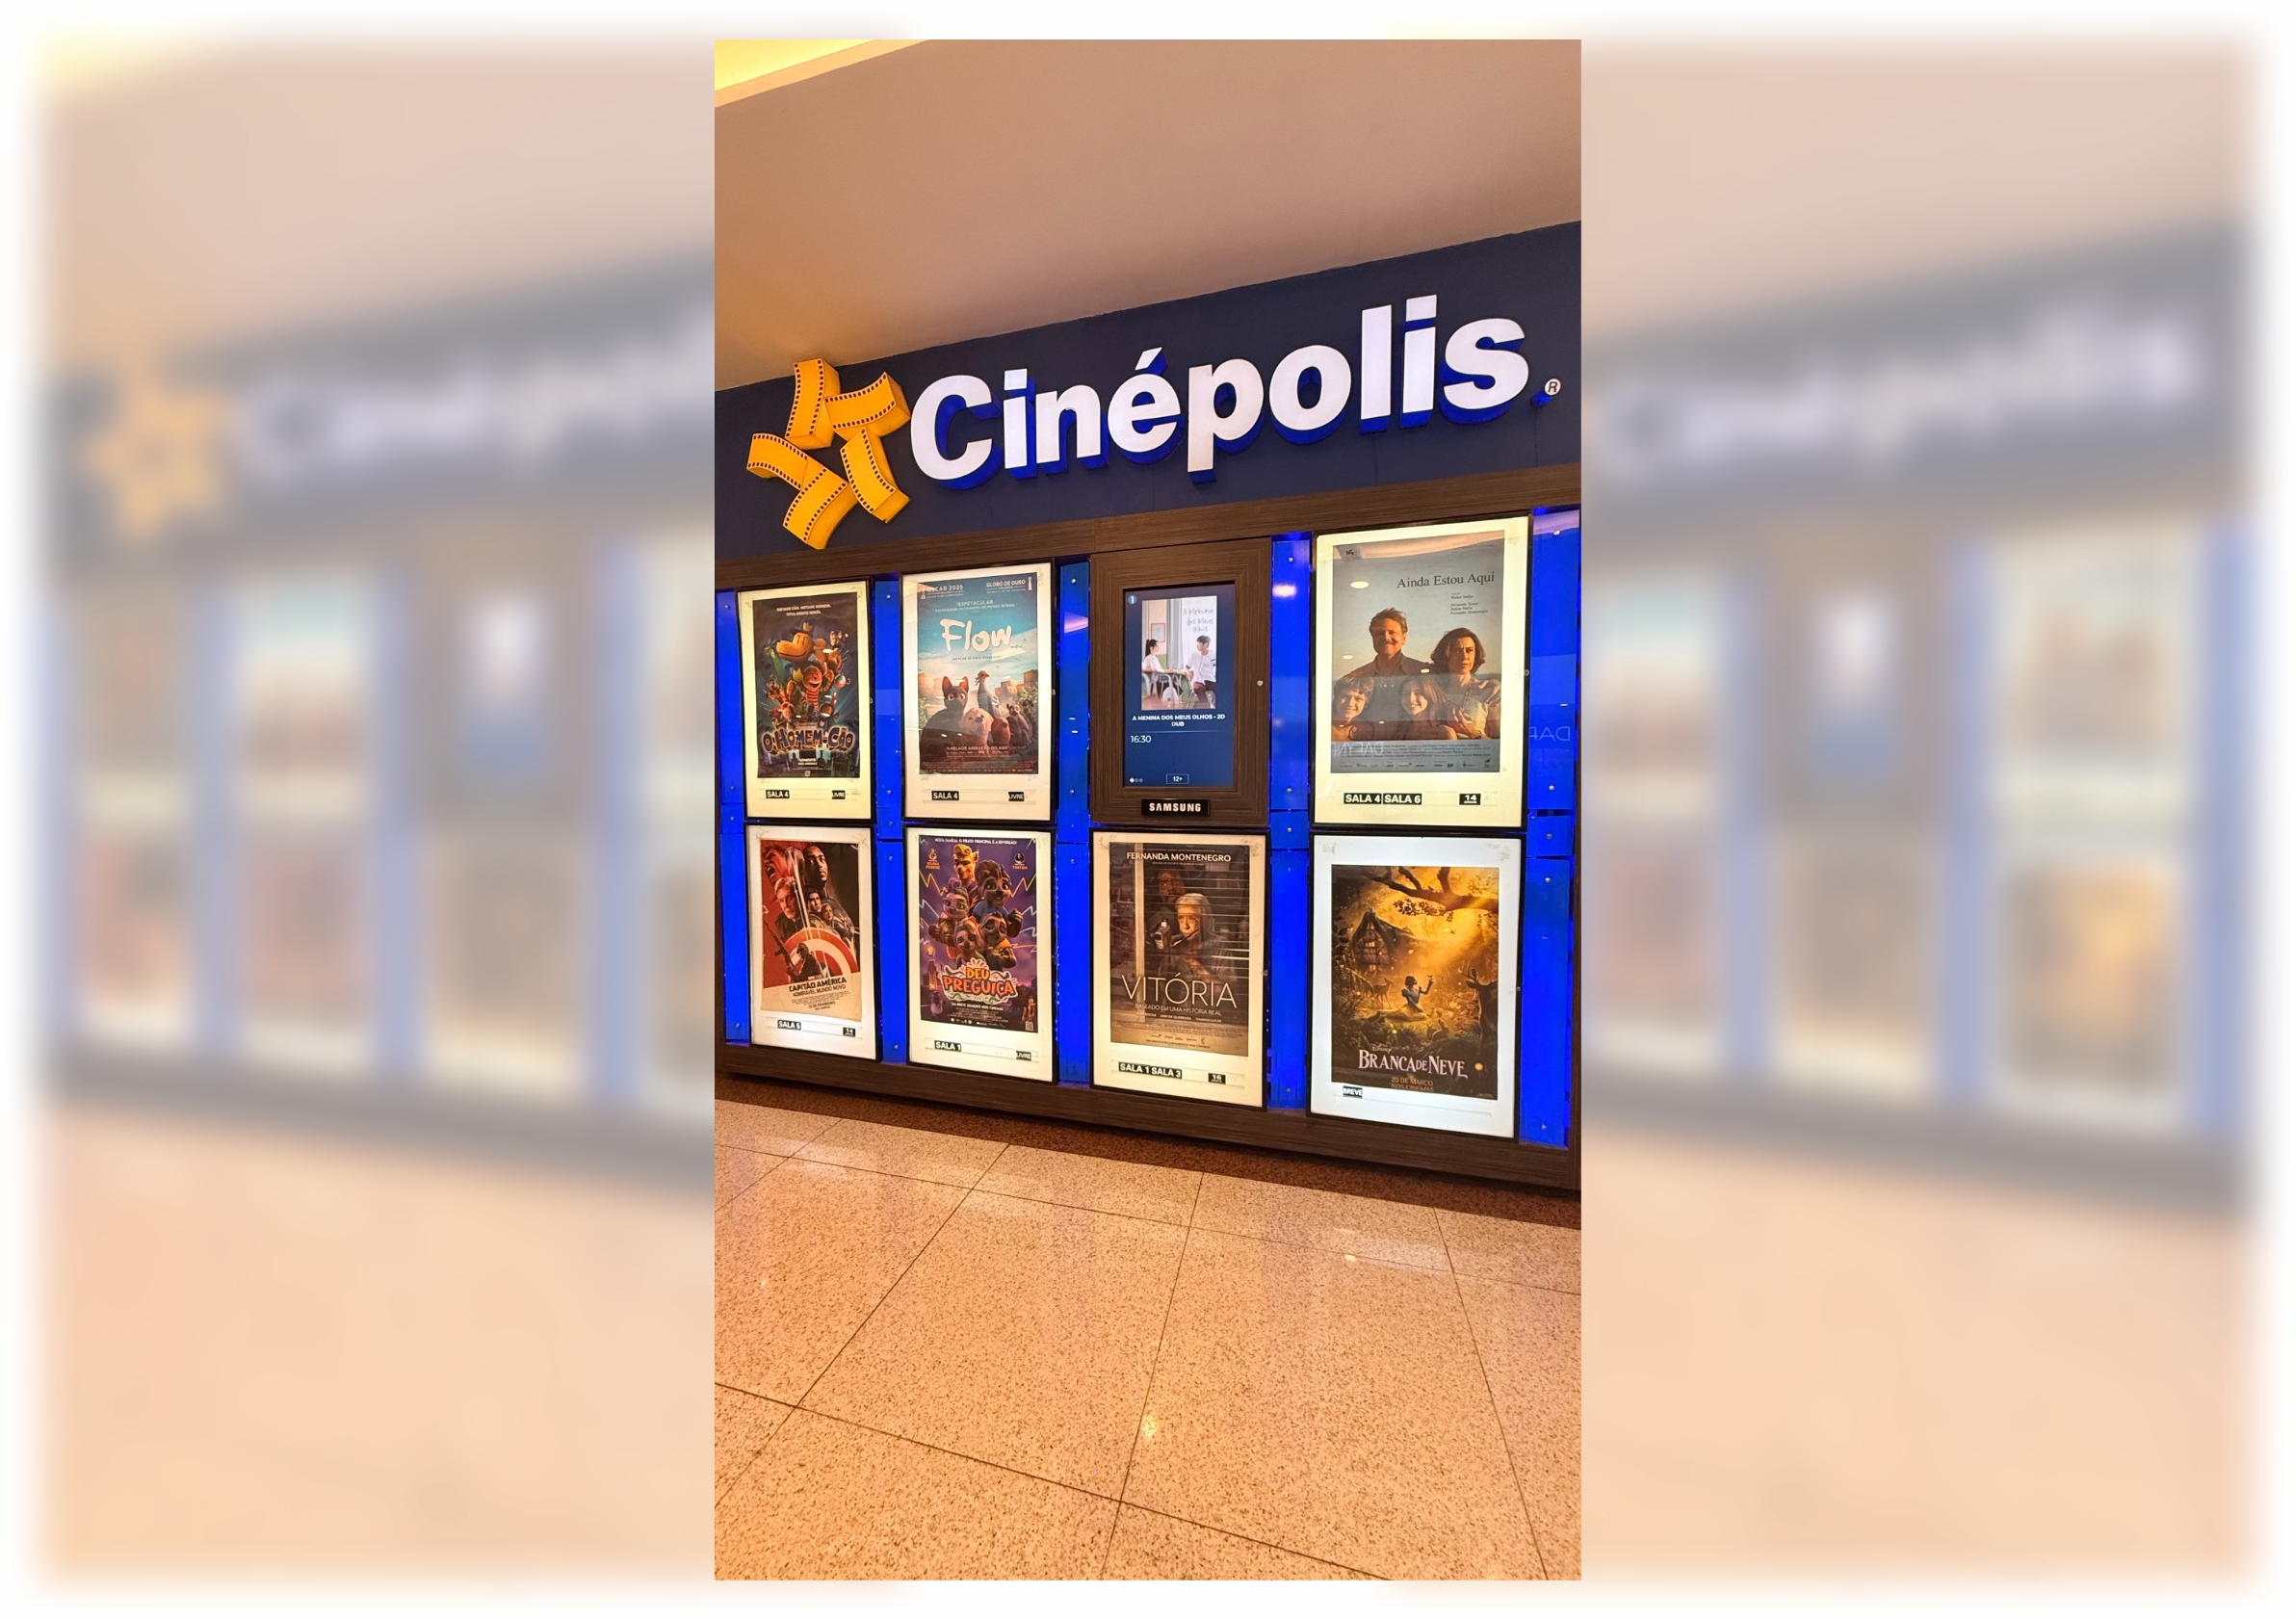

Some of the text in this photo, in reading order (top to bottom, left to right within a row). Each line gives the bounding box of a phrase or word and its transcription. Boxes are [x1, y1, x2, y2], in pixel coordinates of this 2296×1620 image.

[909, 295, 1529, 480] Cinépolis
[1396, 571, 1495, 588] Ainda Estou Aqui
[940, 618, 1012, 652] Flow
[1130, 735, 1152, 743] 16:30
[1384, 795, 1412, 803] SALA
[1414, 795, 1421, 803] 6
[1149, 802, 1202, 812] SAMSUNG
[1127, 852, 1231, 862] FERNANDA MONTENEGRO
[966, 967, 990, 980] DEU
[788, 982, 816, 992] CAPITÃO
[817, 977, 847, 987] AMÉRICA
[942, 976, 1015, 997] PREGUIÇA
[1121, 972, 1237, 1008] VITÓRIA
[936, 1042, 955, 1050] SALA
[1120, 1063, 1143, 1072] SALA
[1152, 1067, 1174, 1076] SALA
[1358, 1049, 1468, 1078] BRANCA DE NEVE
[1411, 1078, 1433, 1086] MARÇO
[1343, 1087, 1363, 1096] BREVE
